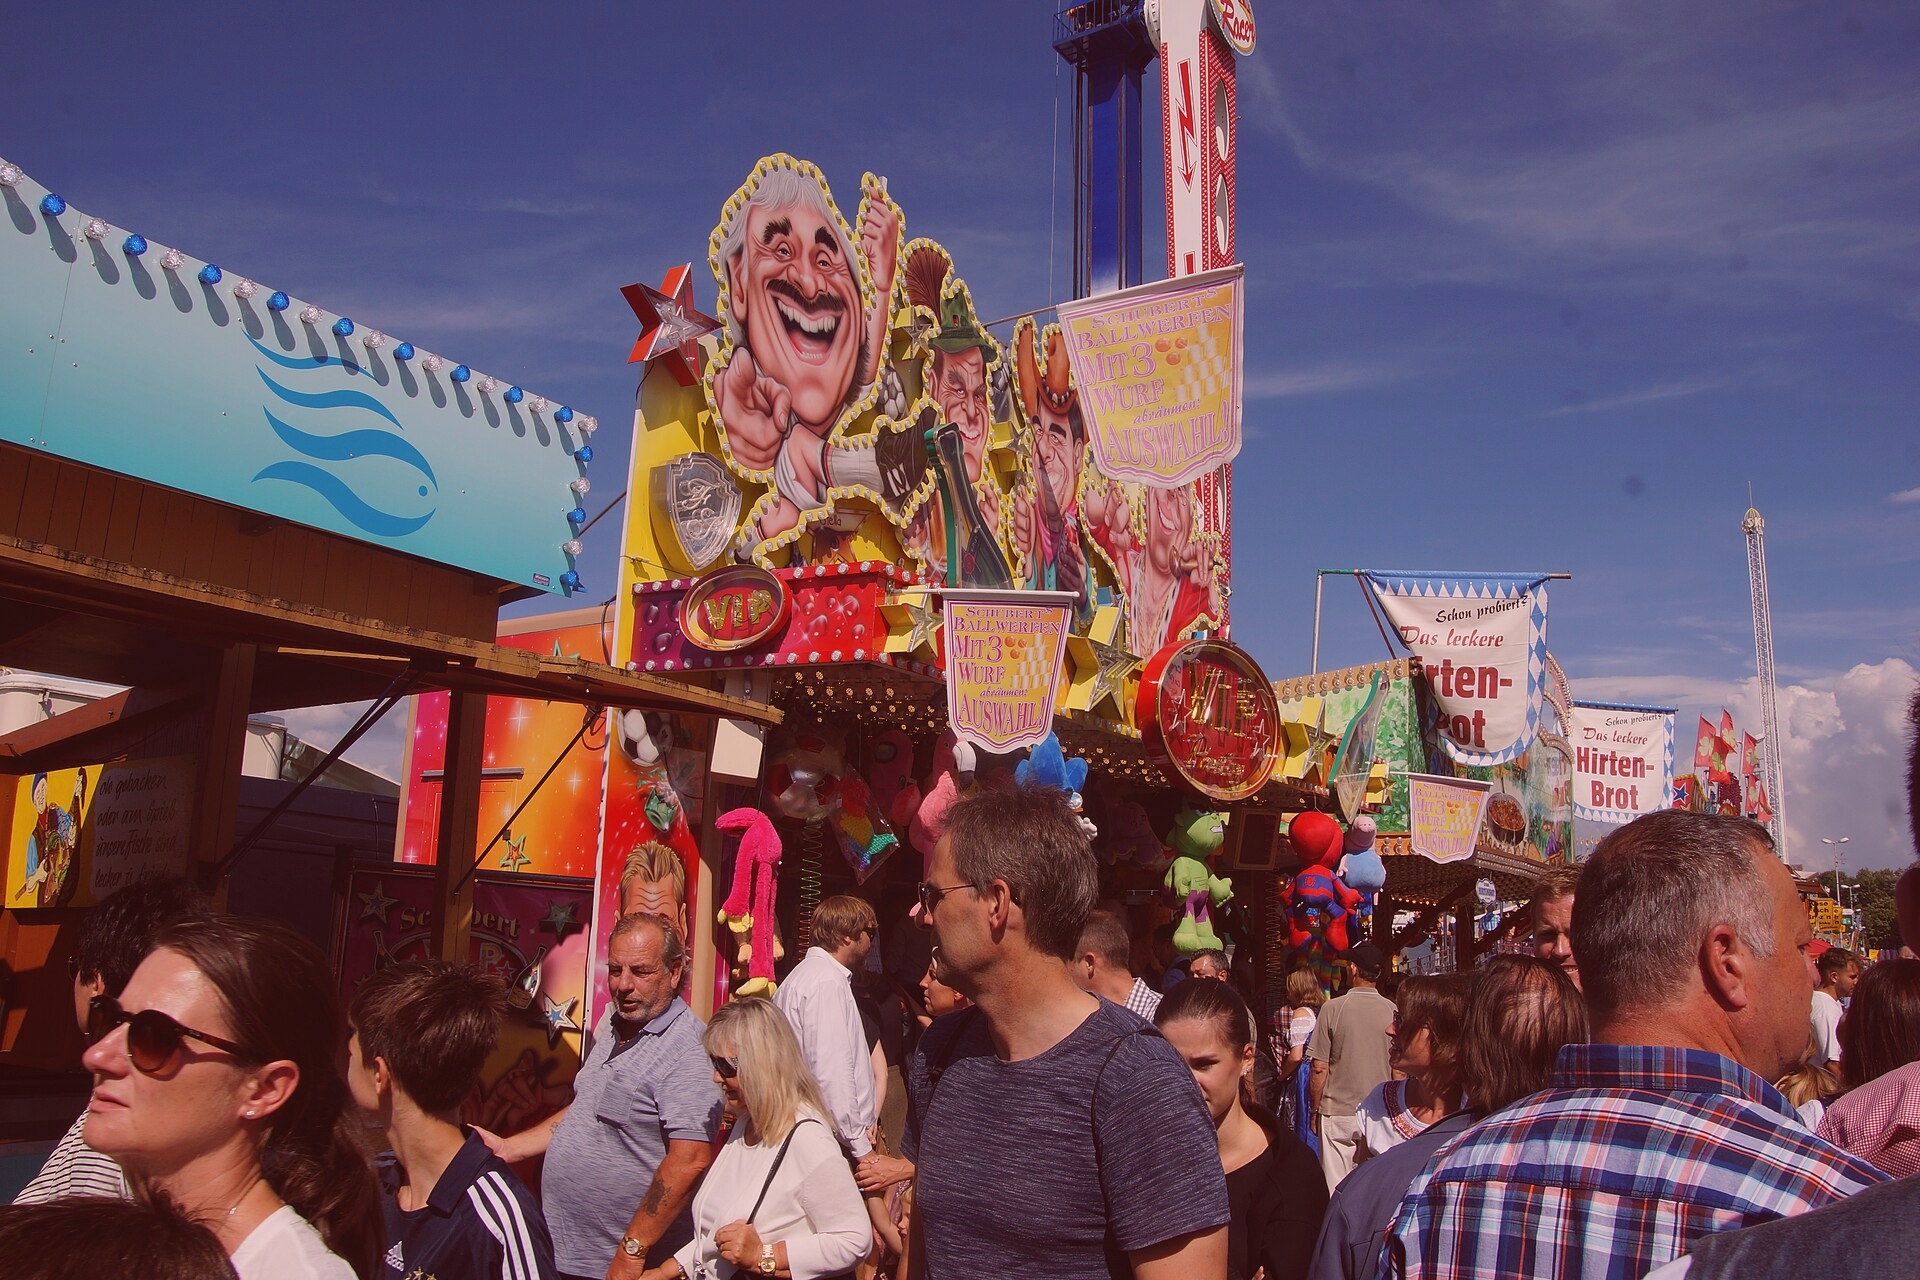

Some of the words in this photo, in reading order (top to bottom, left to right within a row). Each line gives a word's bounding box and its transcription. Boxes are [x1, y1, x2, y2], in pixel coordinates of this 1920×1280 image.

[1077, 303, 1233, 352] BALLWERFEN
[1130, 341, 1157, 378] 3
[1092, 378, 1165, 417] WURF
[1103, 399, 1230, 469] AUSWAHL!
[704, 588, 772, 631] VIP
[1435, 608, 1472, 623] Schon
[1477, 595, 1529, 619] probiert?
[953, 616, 1061, 635] BALLWERFEN
[1400, 625, 1439, 646] Das
[1446, 628, 1504, 647] leckere
[986, 635, 1003, 663] 3
[957, 661, 1007, 685] WURF
[957, 693, 1047, 737] AUSWAHL!
[1604, 716, 1628, 727] Schon
[1583, 727, 1608, 741] Das
[1613, 730, 1648, 745] leckere
[1576, 746, 1655, 778] Hirten-
[115, 769, 167, 800] gebacken
[1591, 780, 1639, 811] Brot
[97, 805, 119, 826] oder
[121, 808, 142, 825] am
[1434, 800, 1446, 815] 3
